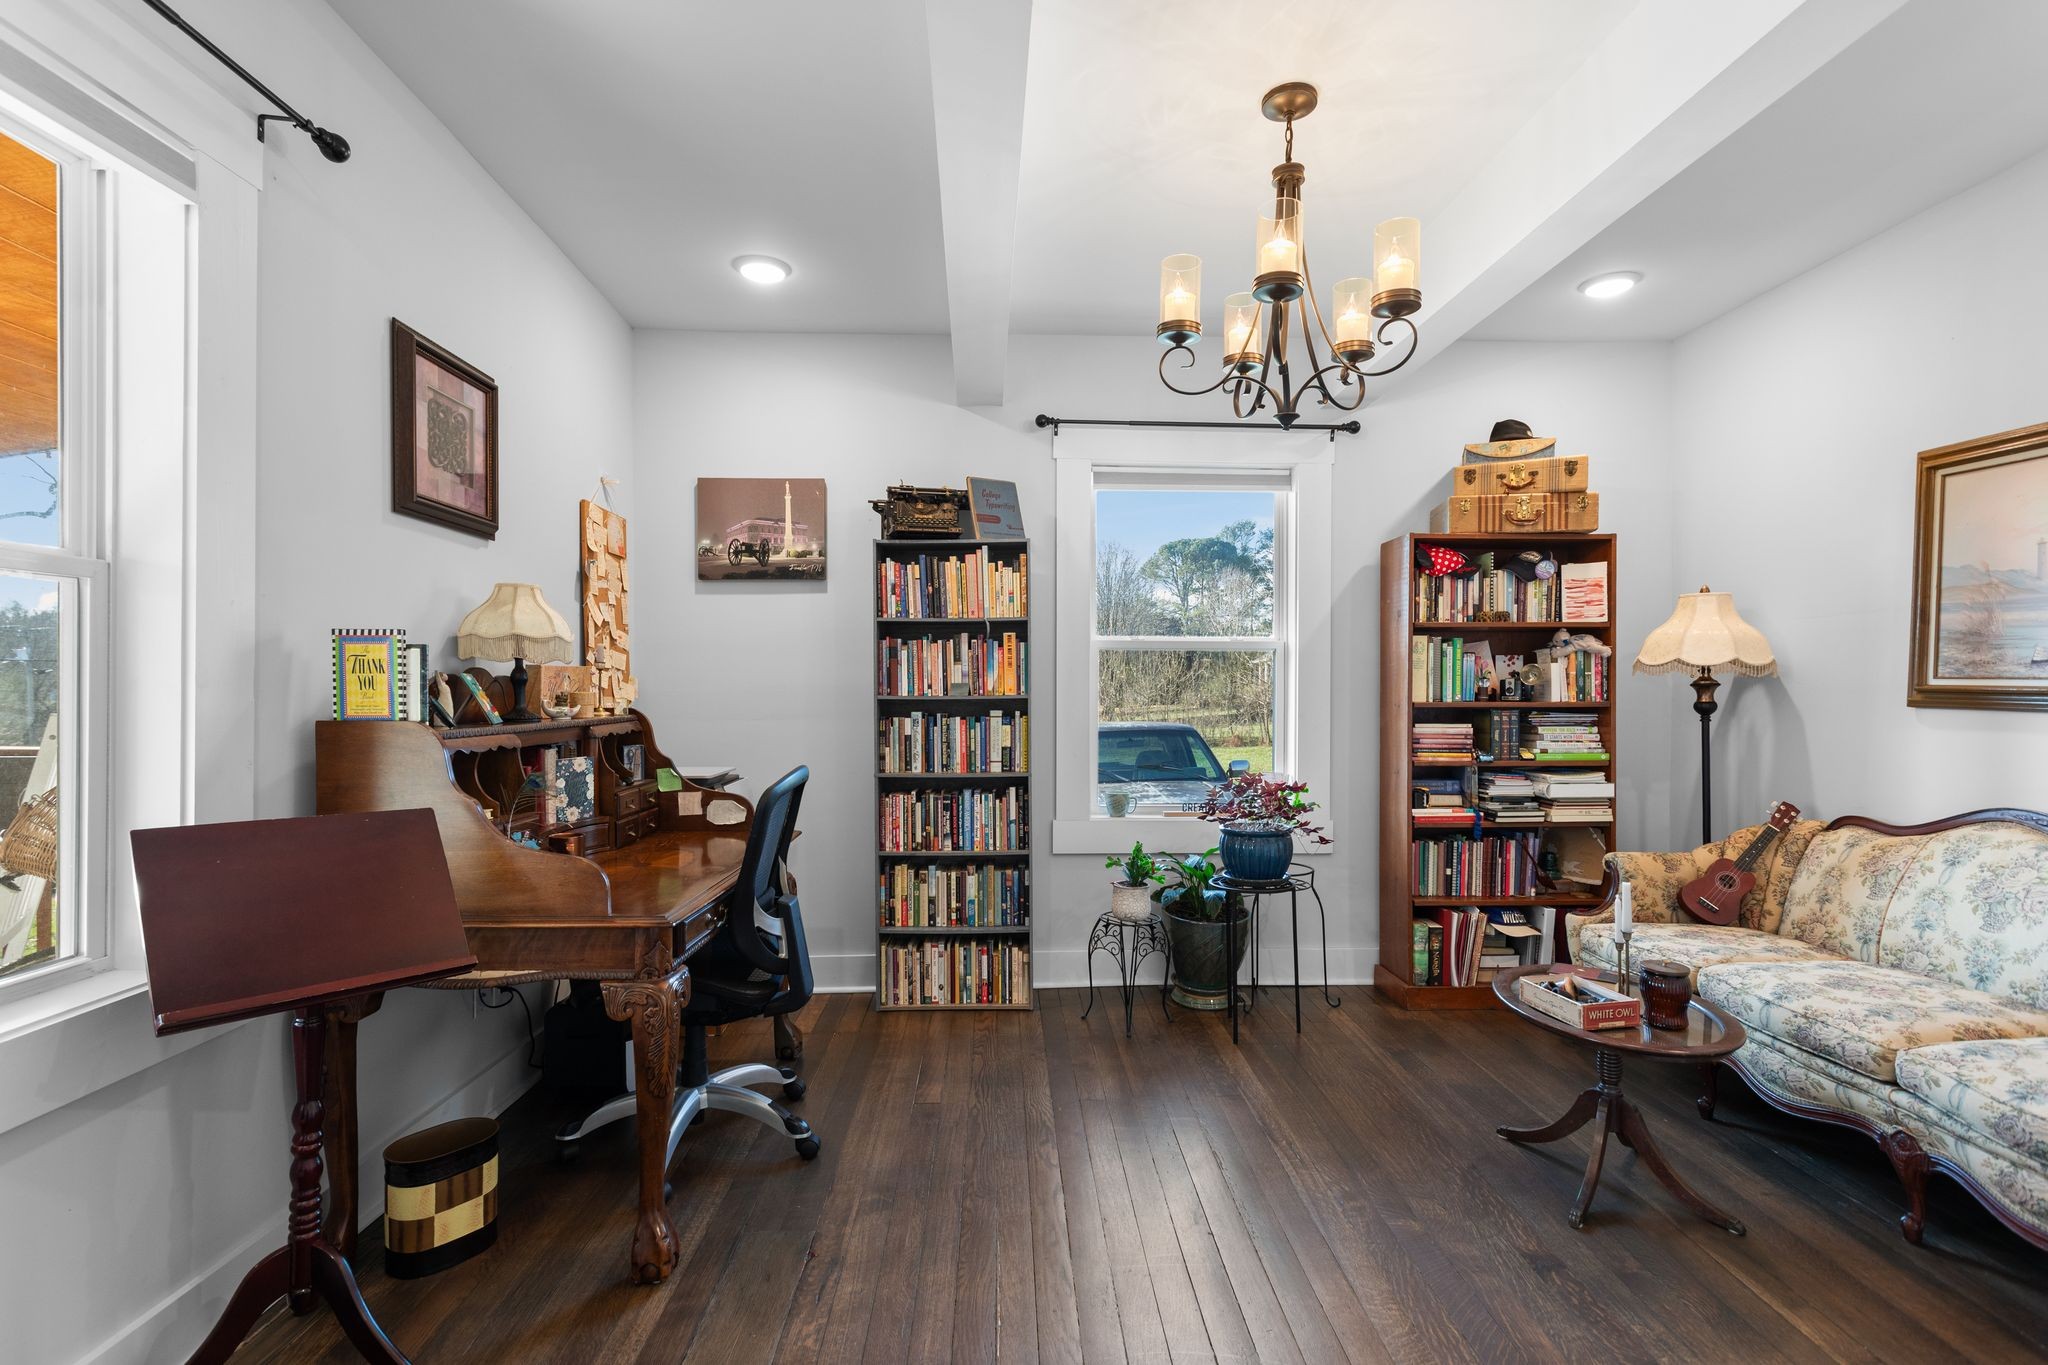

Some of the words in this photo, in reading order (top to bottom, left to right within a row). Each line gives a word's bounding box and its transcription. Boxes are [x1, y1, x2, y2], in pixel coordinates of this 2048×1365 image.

[347, 654, 386, 674] THANK
[357, 675, 377, 691] YOU
[1182, 803, 1208, 812] CREAT
[1588, 1009, 1614, 1020] WHITE
[1615, 1007, 1636, 1018] OWL
